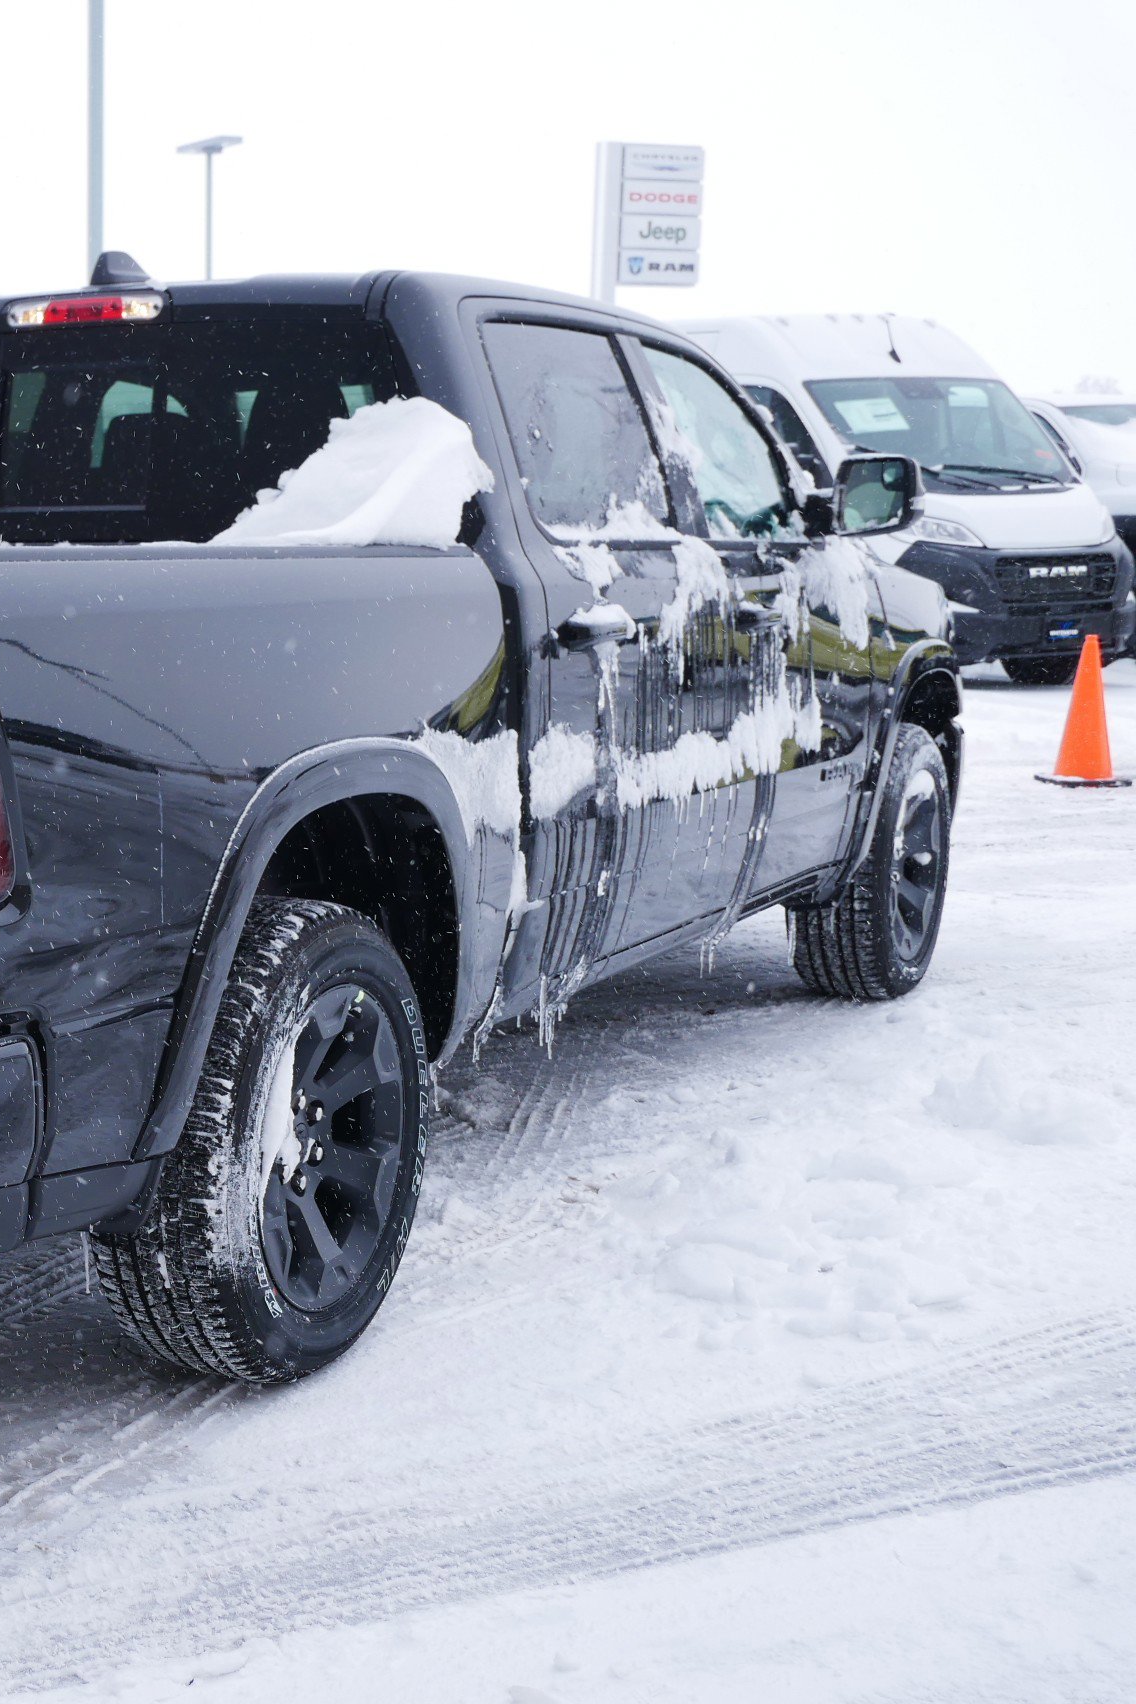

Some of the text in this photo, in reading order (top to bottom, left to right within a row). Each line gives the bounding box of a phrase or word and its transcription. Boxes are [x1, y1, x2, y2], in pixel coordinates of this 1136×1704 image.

[629, 192, 698, 204] DODGE
[639, 221, 687, 244] Jeep
[648, 262, 694, 273] RAM
[1029, 565, 1088, 578] RAM
[401, 998, 429, 1196] DUELER
